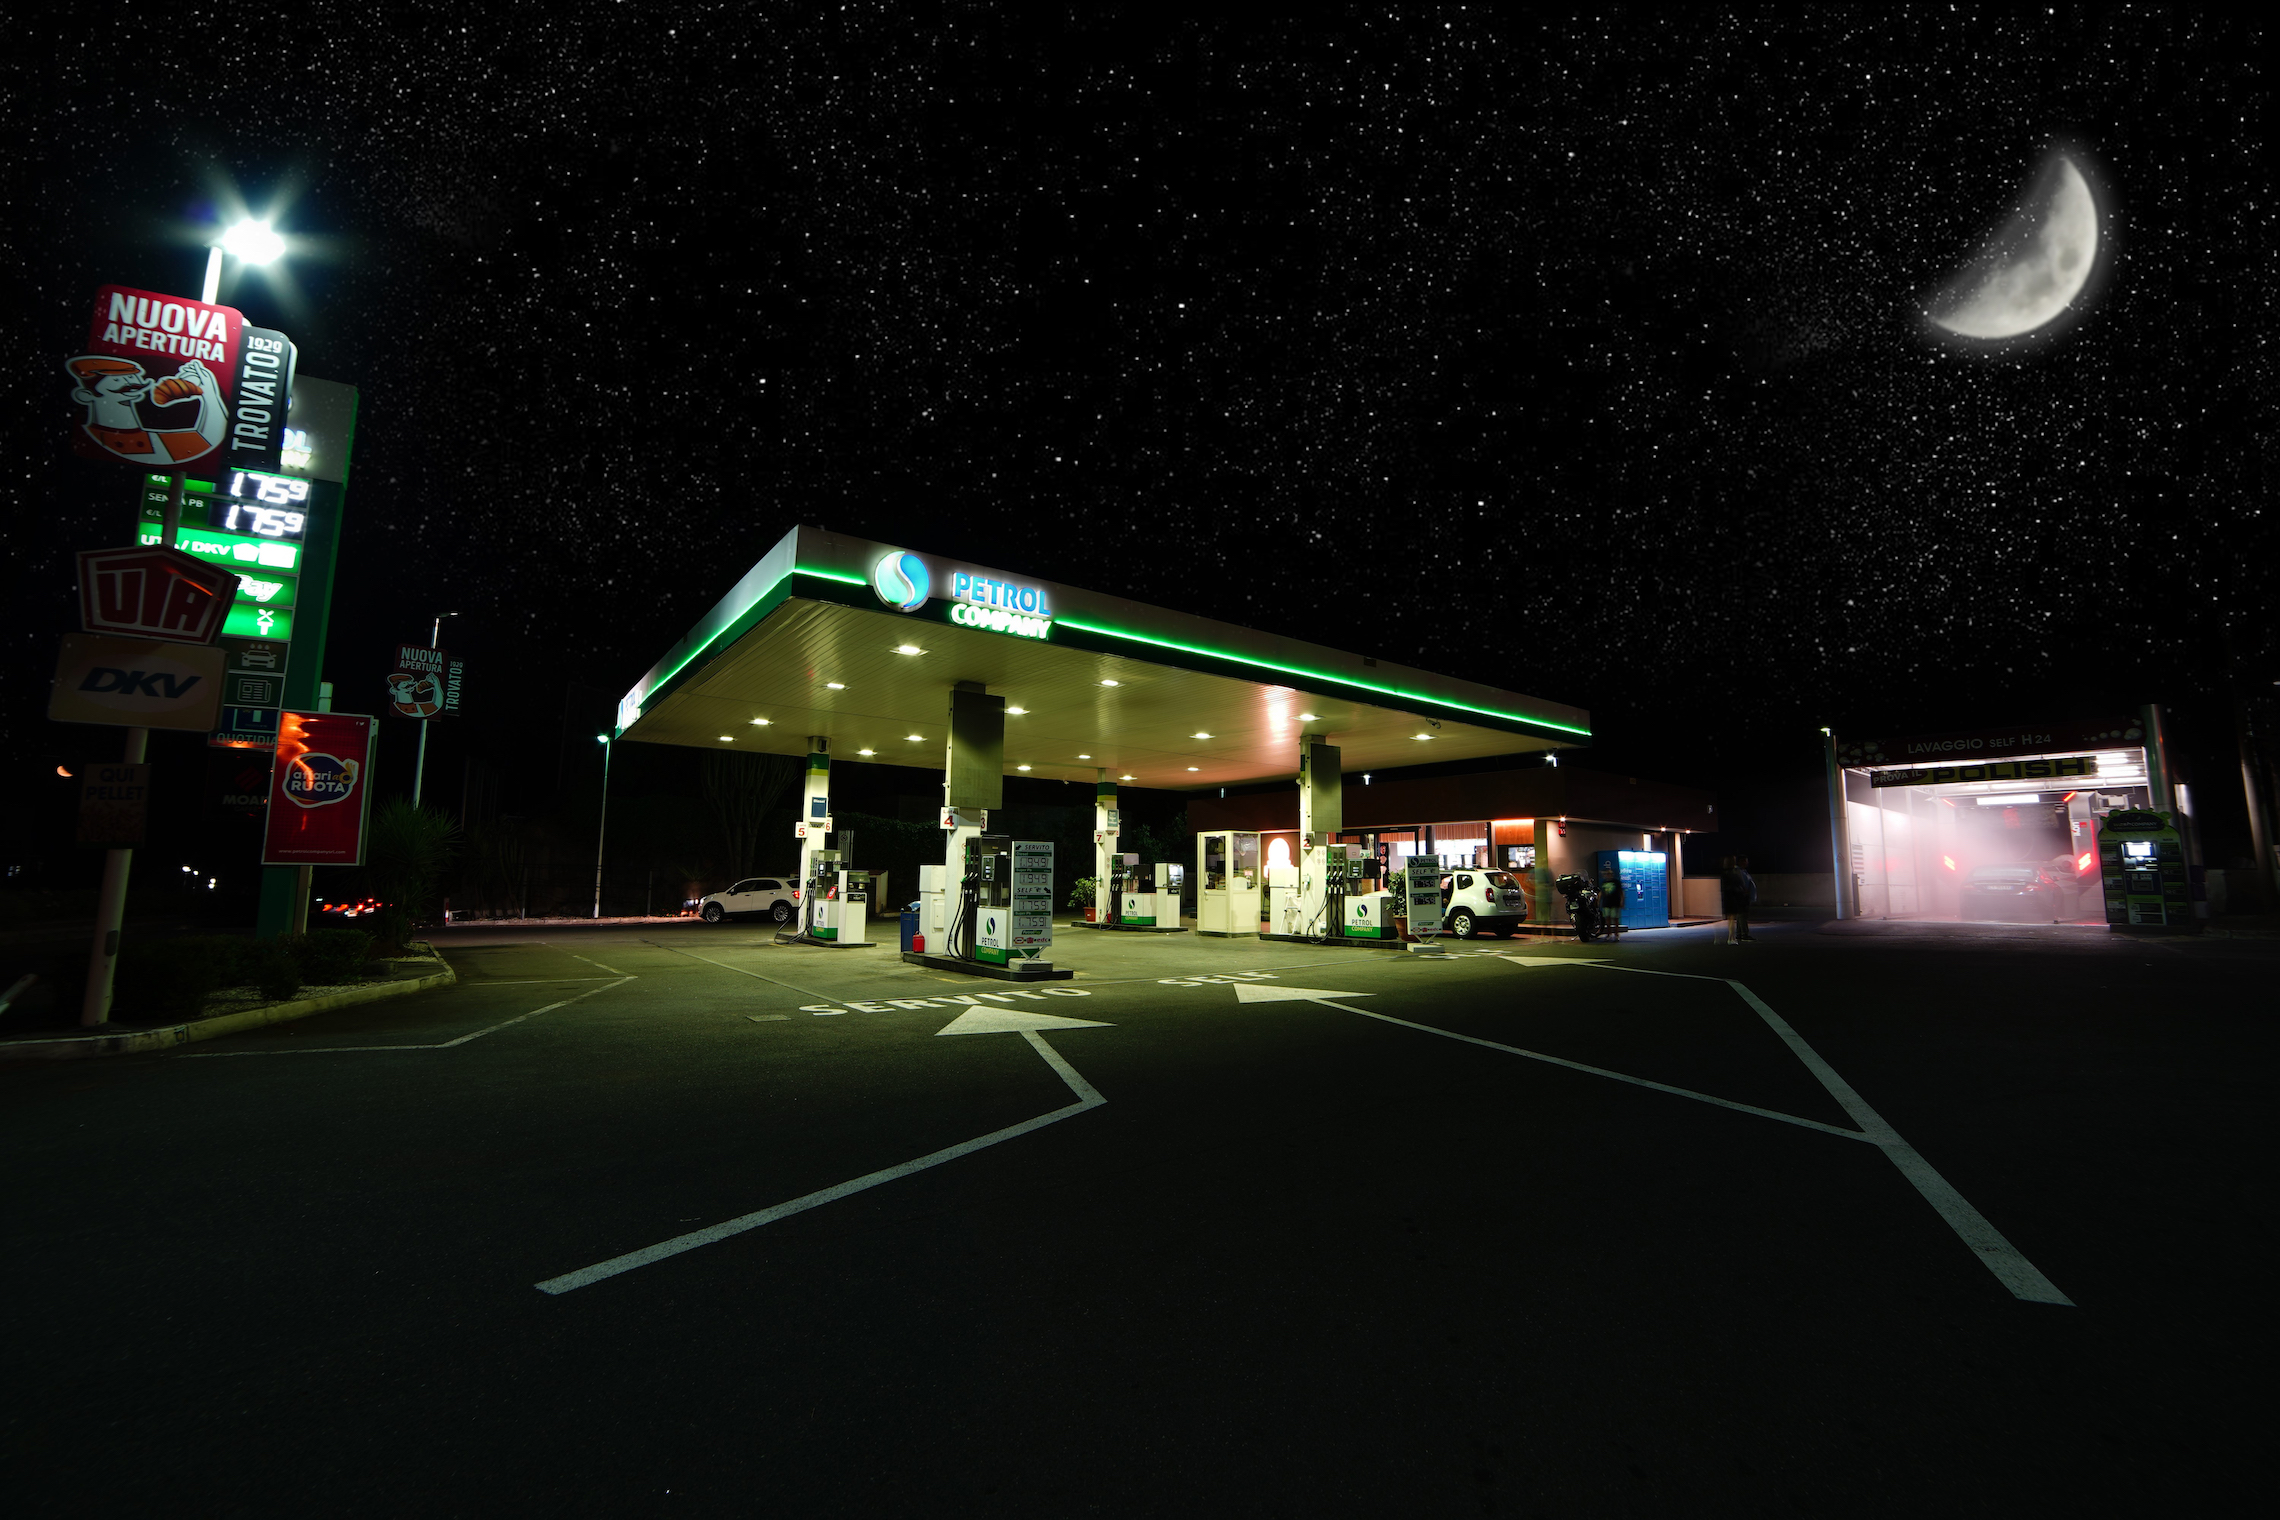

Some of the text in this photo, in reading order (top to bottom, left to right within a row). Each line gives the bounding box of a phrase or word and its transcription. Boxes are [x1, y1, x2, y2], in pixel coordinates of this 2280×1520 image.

[108, 292, 227, 342] NUOVA
[102, 323, 225, 363] APERTURA
[247, 336, 283, 354] 1929
[231, 351, 280, 451] TROVATO
[188, 498, 204, 508] PB
[192, 541, 231, 556] DKV
[953, 572, 1051, 617] PETROL
[951, 603, 1052, 639] COMPANY
[401, 647, 443, 664] NUOVA
[399, 660, 442, 673] APERTURA
[78, 667, 202, 699] DKV
[445, 667, 464, 710] TROVATO
[1907, 738, 1984, 754] LAVAGGIO
[1989, 737, 2016, 749] SELF
[2037, 734, 2052, 744] 24
[101, 768, 135, 782] QUI
[1872, 769, 1923, 785] PROVA IL
[1932, 757, 2085, 783] POLISH
[86, 786, 144, 800] PELLET
[291, 780, 345, 793] RUOTA
[826, 822, 831, 831] 6
[944, 815, 954, 827] 4
[981, 817, 986, 829] 3
[798, 827, 805, 836] 5
[1303, 838, 1311, 847] 2
[982, 937, 999, 947] PETROL
[981, 946, 1000, 955] COMPANY
[1157, 971, 1280, 987] SELF
[799, 987, 1092, 1016] SERVITO
